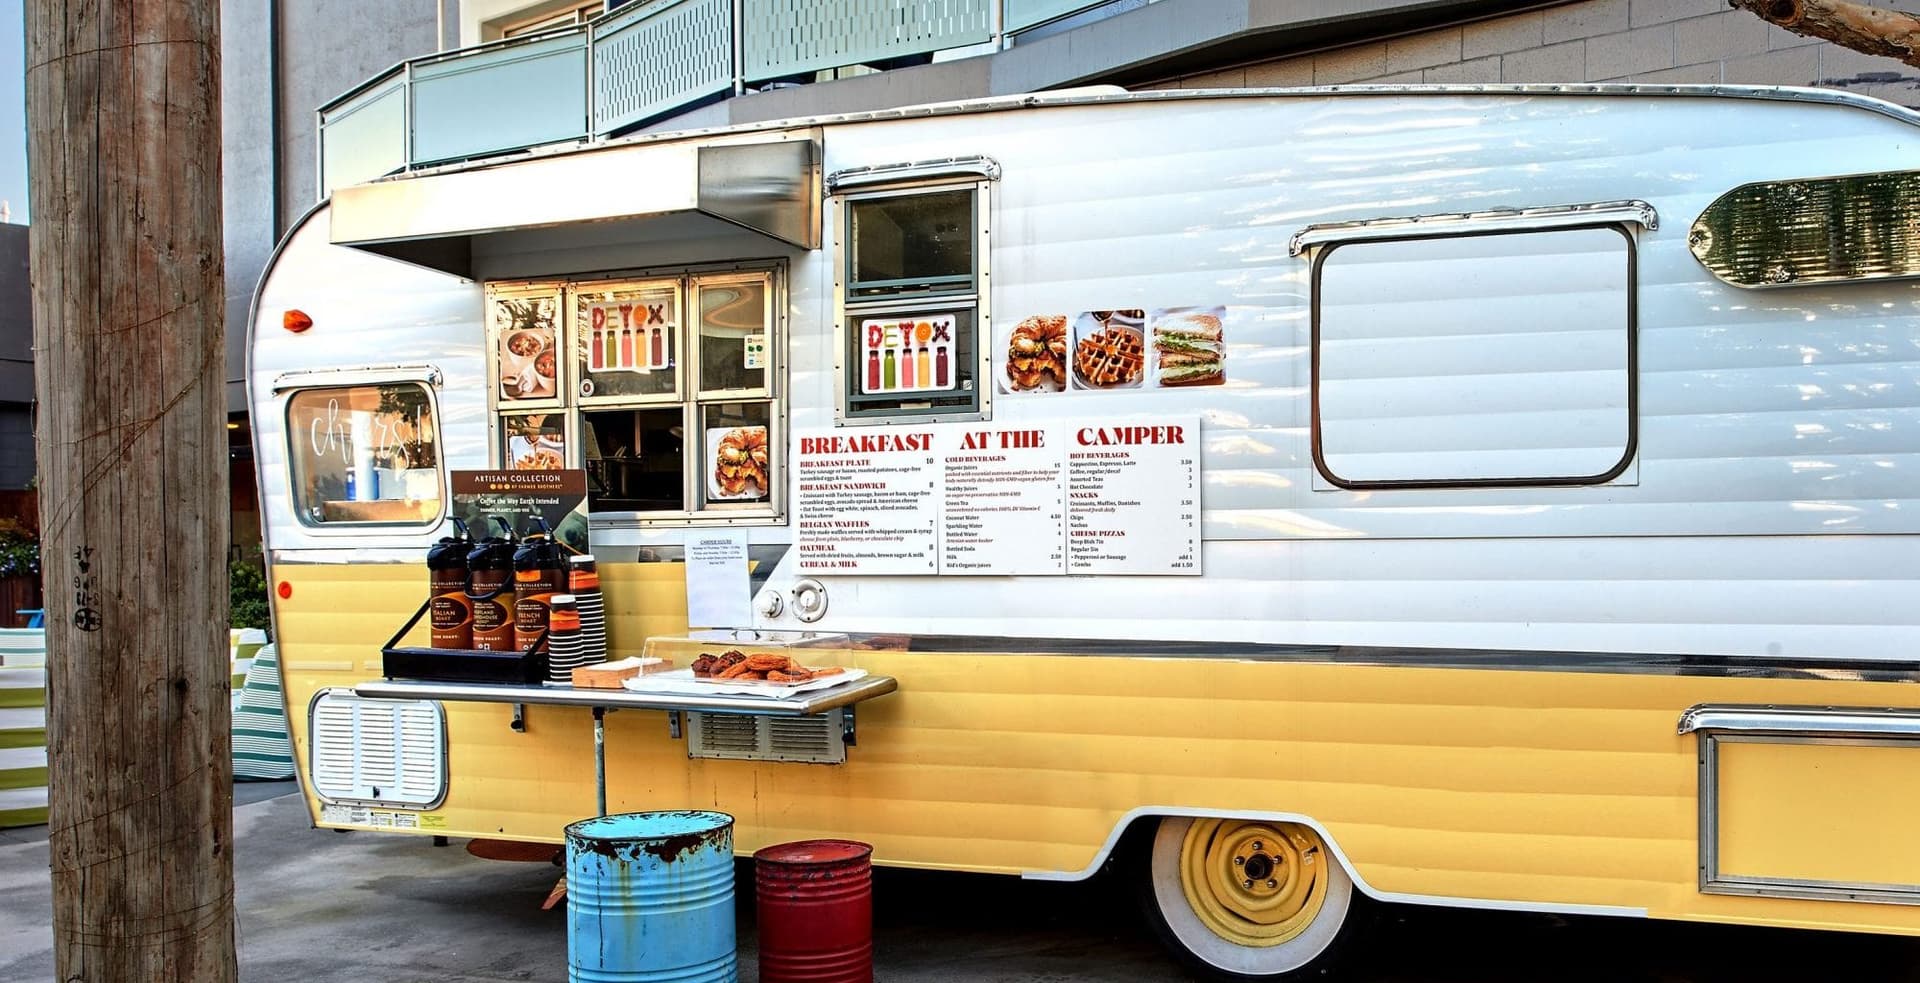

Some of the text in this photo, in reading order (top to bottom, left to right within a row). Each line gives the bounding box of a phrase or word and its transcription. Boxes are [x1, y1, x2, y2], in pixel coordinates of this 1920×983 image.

[592, 304, 664, 330] DETOX
[868, 320, 950, 348] DETOX
[311, 399, 421, 481] chrs!
[801, 425, 1184, 454] BREAKFAST AT THE CAMPER
[507, 498, 518, 506] Way
